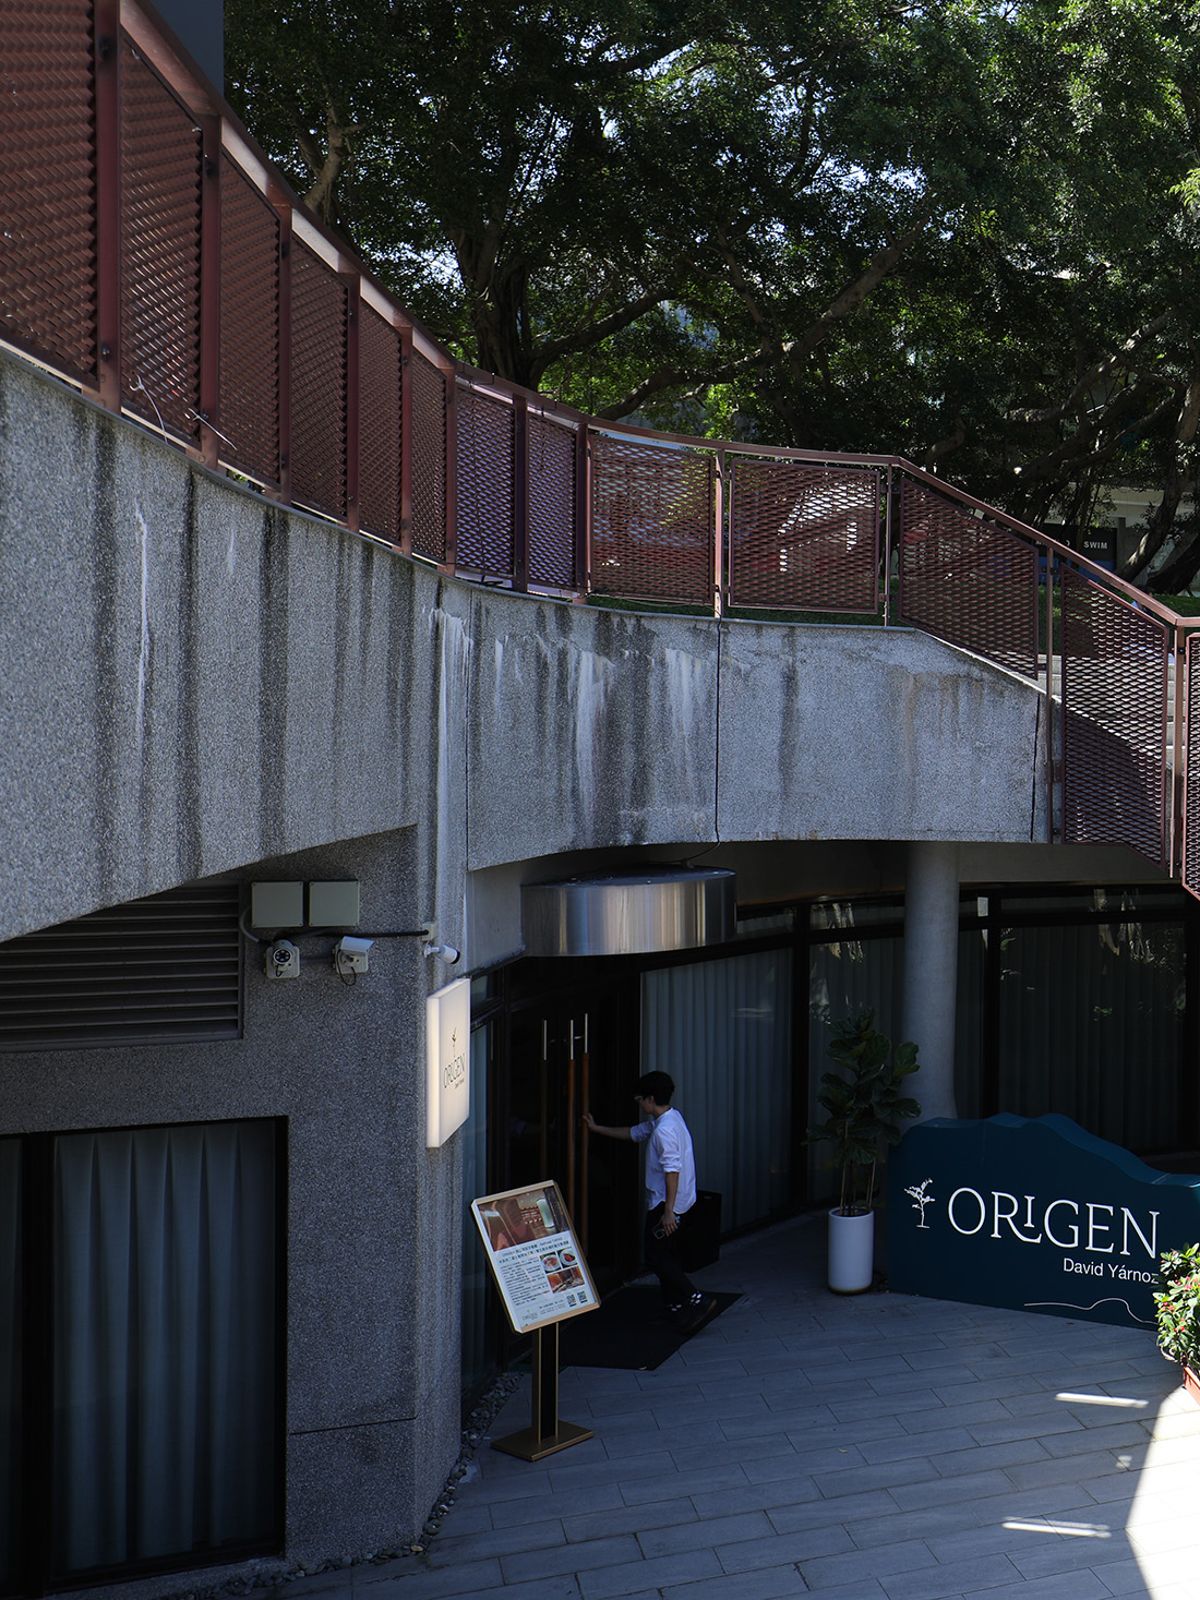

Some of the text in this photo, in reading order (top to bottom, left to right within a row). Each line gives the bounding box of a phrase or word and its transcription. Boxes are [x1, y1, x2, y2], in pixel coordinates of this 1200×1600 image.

[1083, 540, 1108, 549] SWIM
[948, 1187, 1160, 1259] ORIGEN
[1063, 1257, 1104, 1277] David
